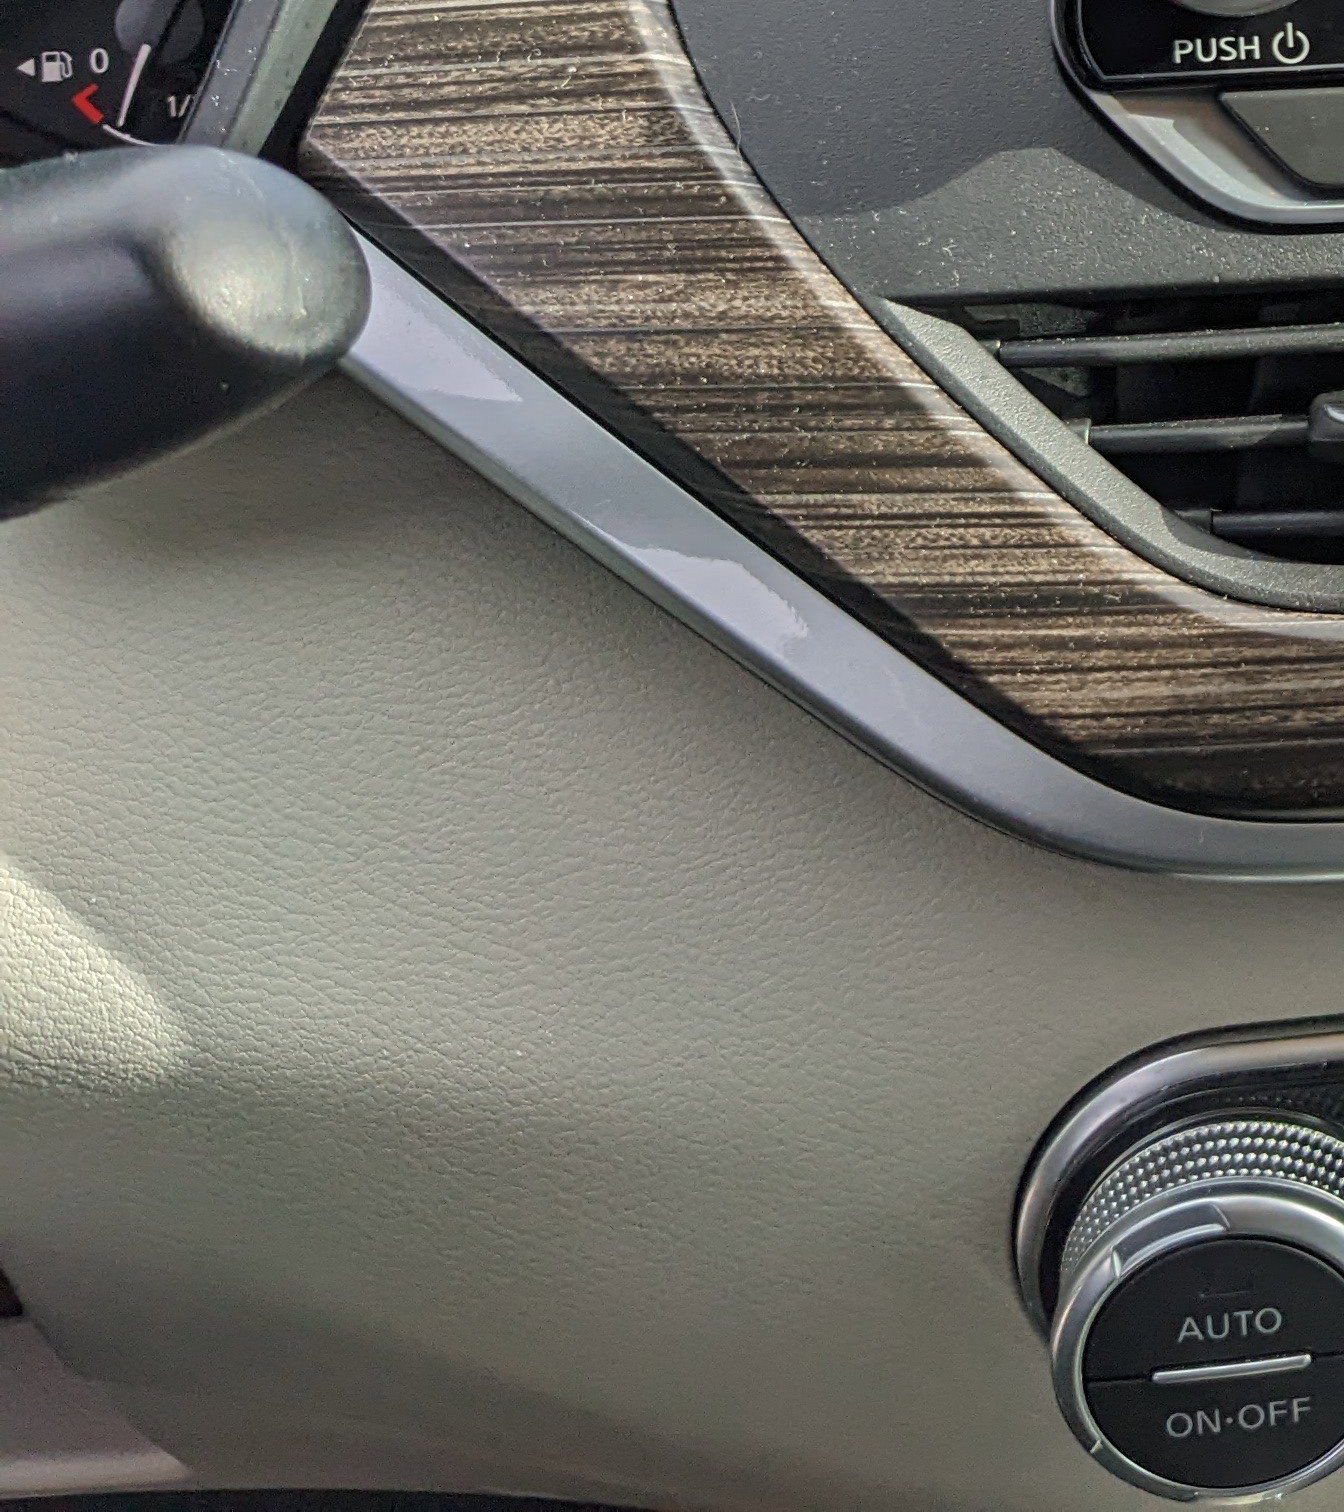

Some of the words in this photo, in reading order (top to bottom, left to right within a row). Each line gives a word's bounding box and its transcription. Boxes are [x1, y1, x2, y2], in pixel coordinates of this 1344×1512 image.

[89, 48, 110, 74] 0
[1173, 36, 1260, 64] PUSH
[1177, 1307, 1283, 1343] AUTO
